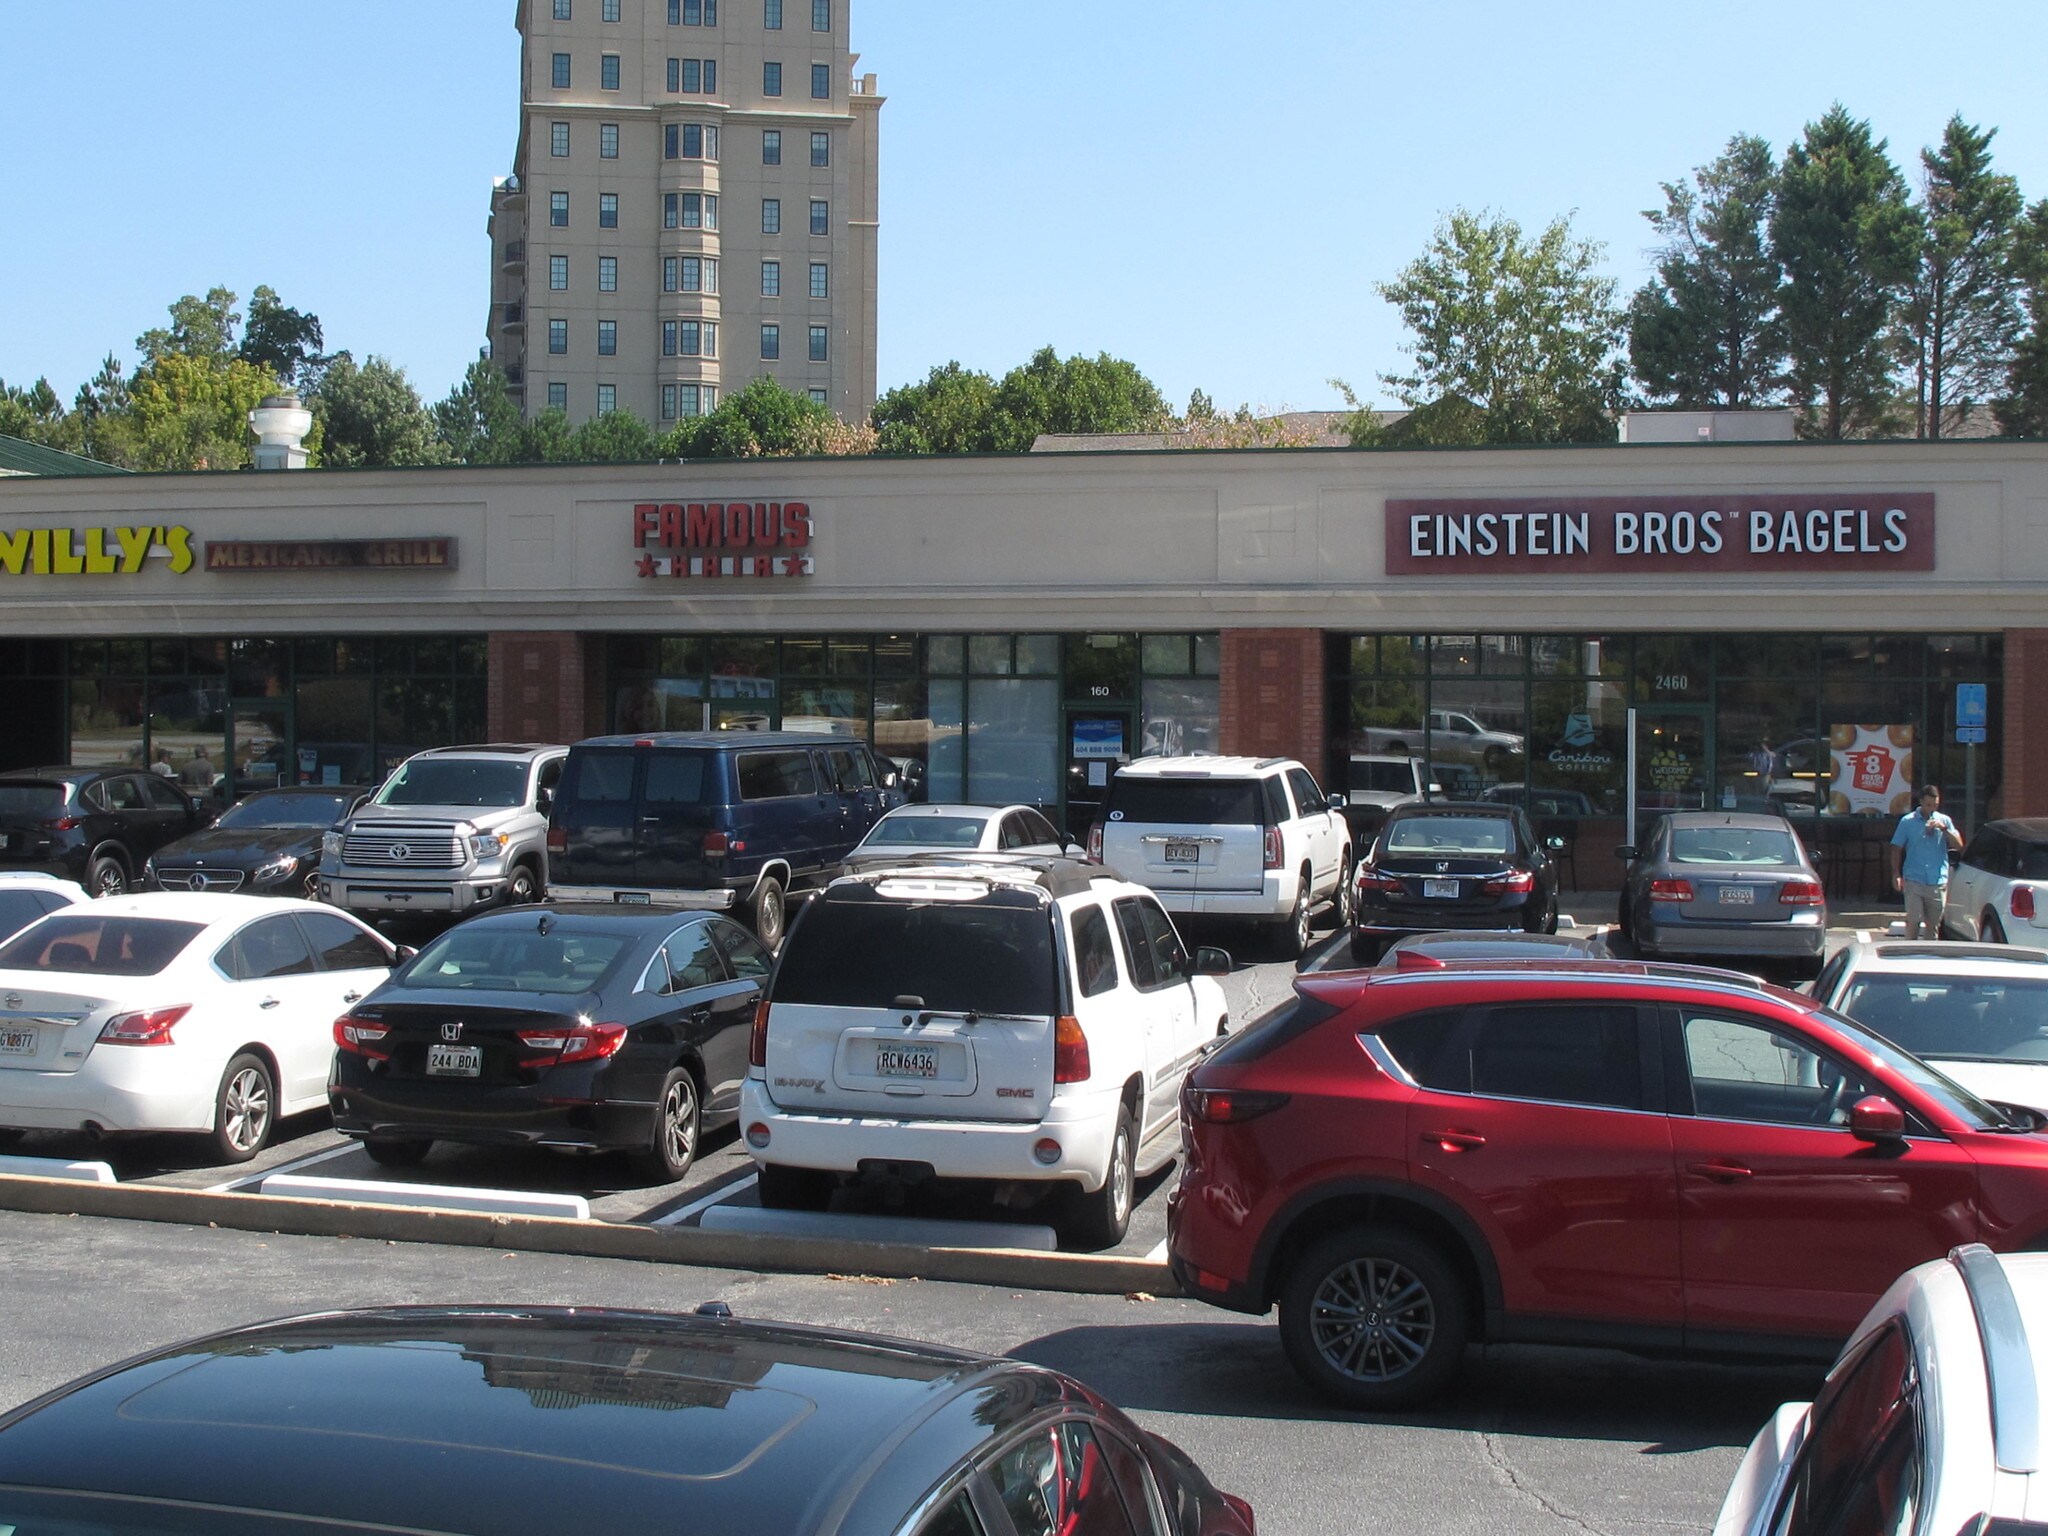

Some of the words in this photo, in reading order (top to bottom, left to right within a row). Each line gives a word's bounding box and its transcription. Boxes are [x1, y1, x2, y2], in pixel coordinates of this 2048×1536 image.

[634, 502, 809, 548] FAMOUS
[1410, 512, 1590, 556] EINSTEIN
[1749, 509, 1908, 553] BAGELS
[364, 542, 443, 565] GRILL
[671, 555, 773, 577] HAIR
[1655, 675, 1688, 690] 2460
[1090, 686, 1110, 696] 160
[1549, 750, 1612, 764] Caribou
[431, 1054, 451, 1067] 244
[458, 1055, 478, 1069] BDA
[881, 1052, 933, 1070] RCW6436
[996, 1088, 1034, 1098] GMC
